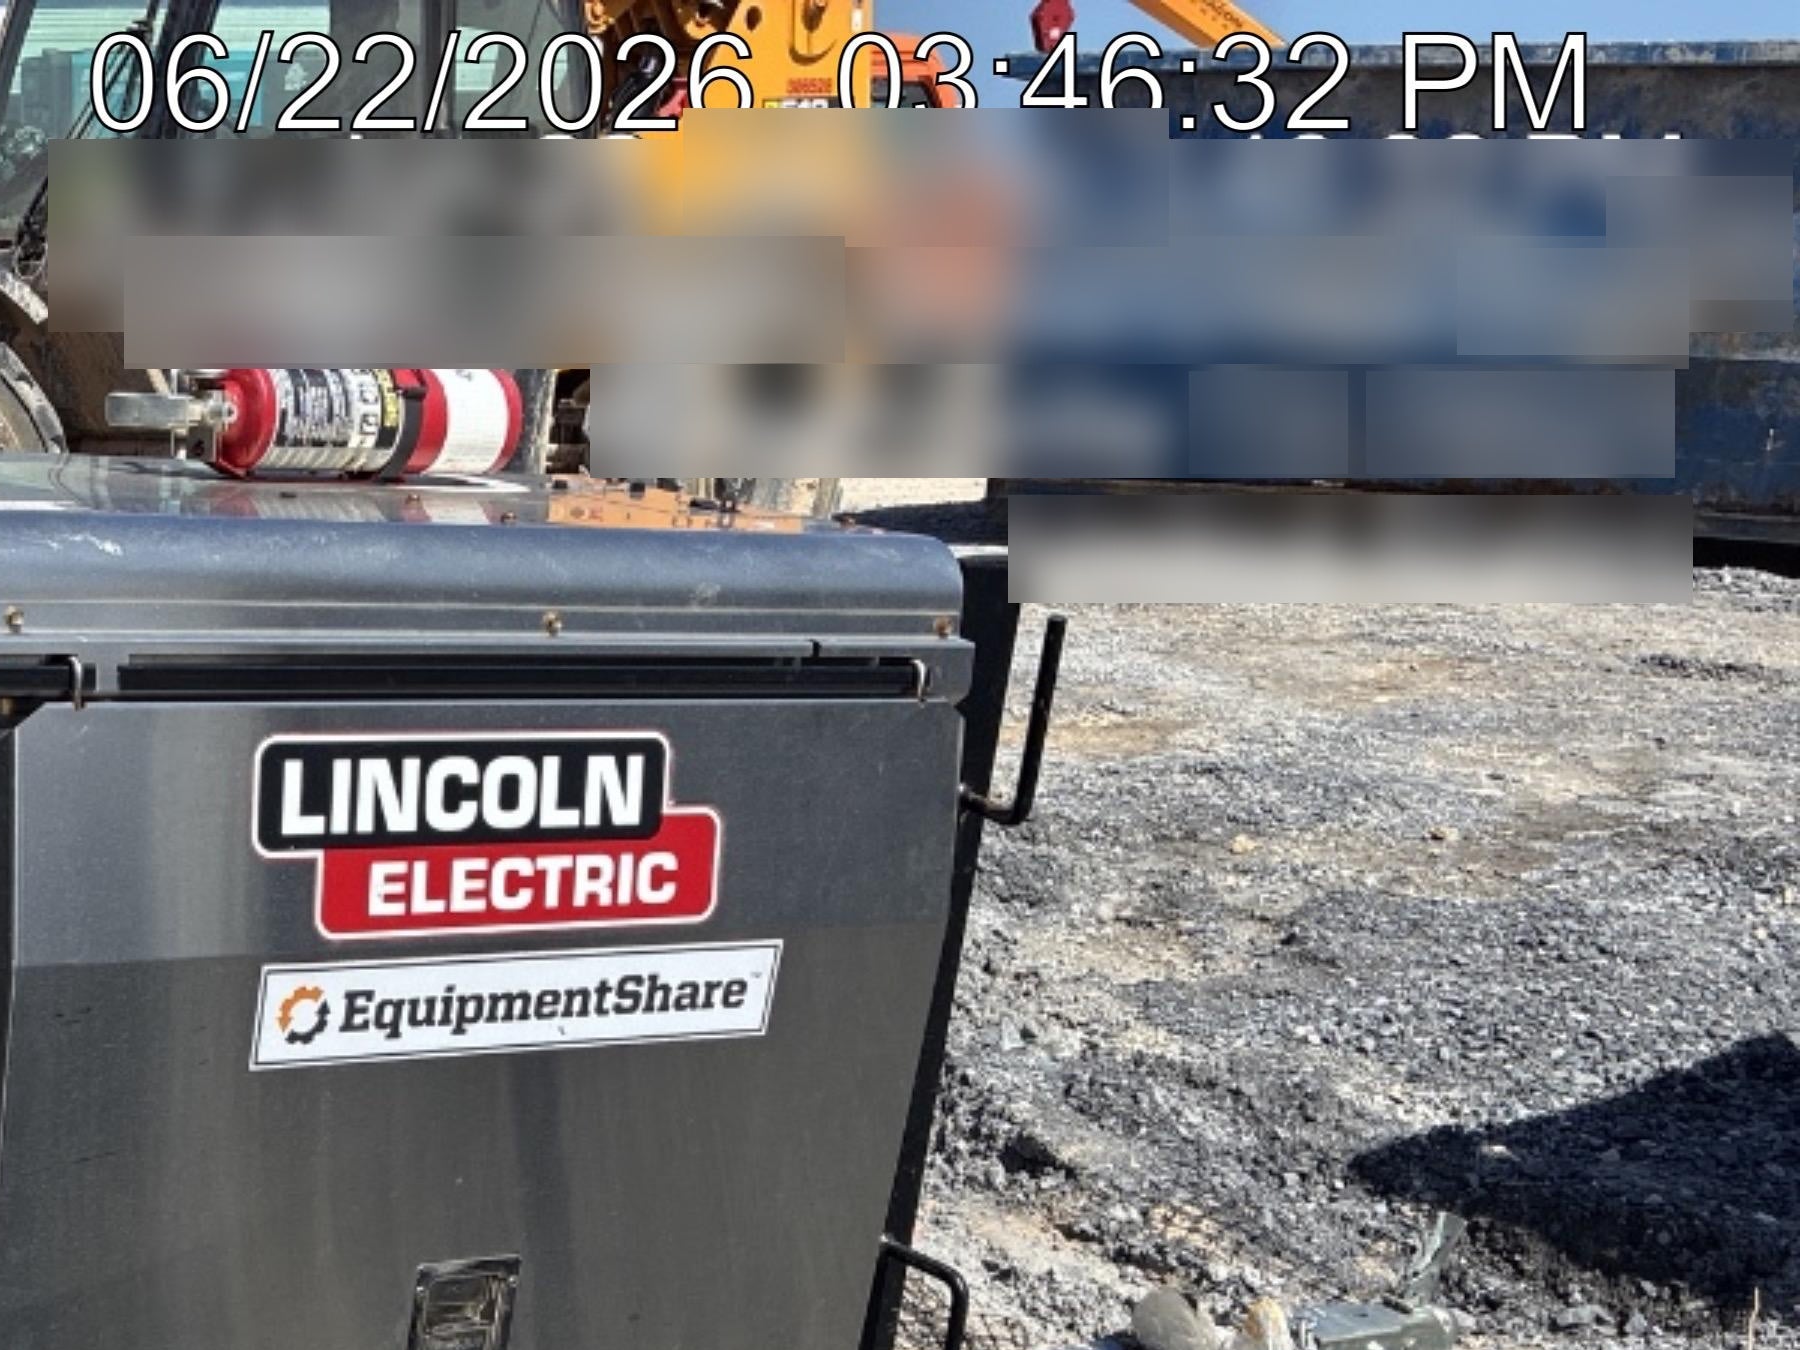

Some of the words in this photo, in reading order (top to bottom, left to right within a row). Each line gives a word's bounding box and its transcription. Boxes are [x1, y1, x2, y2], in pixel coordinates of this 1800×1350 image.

[281, 754, 645, 836] LINCOLN
[368, 851, 678, 917] ELECTRIC
[339, 973, 749, 1038] EquipmentShare
